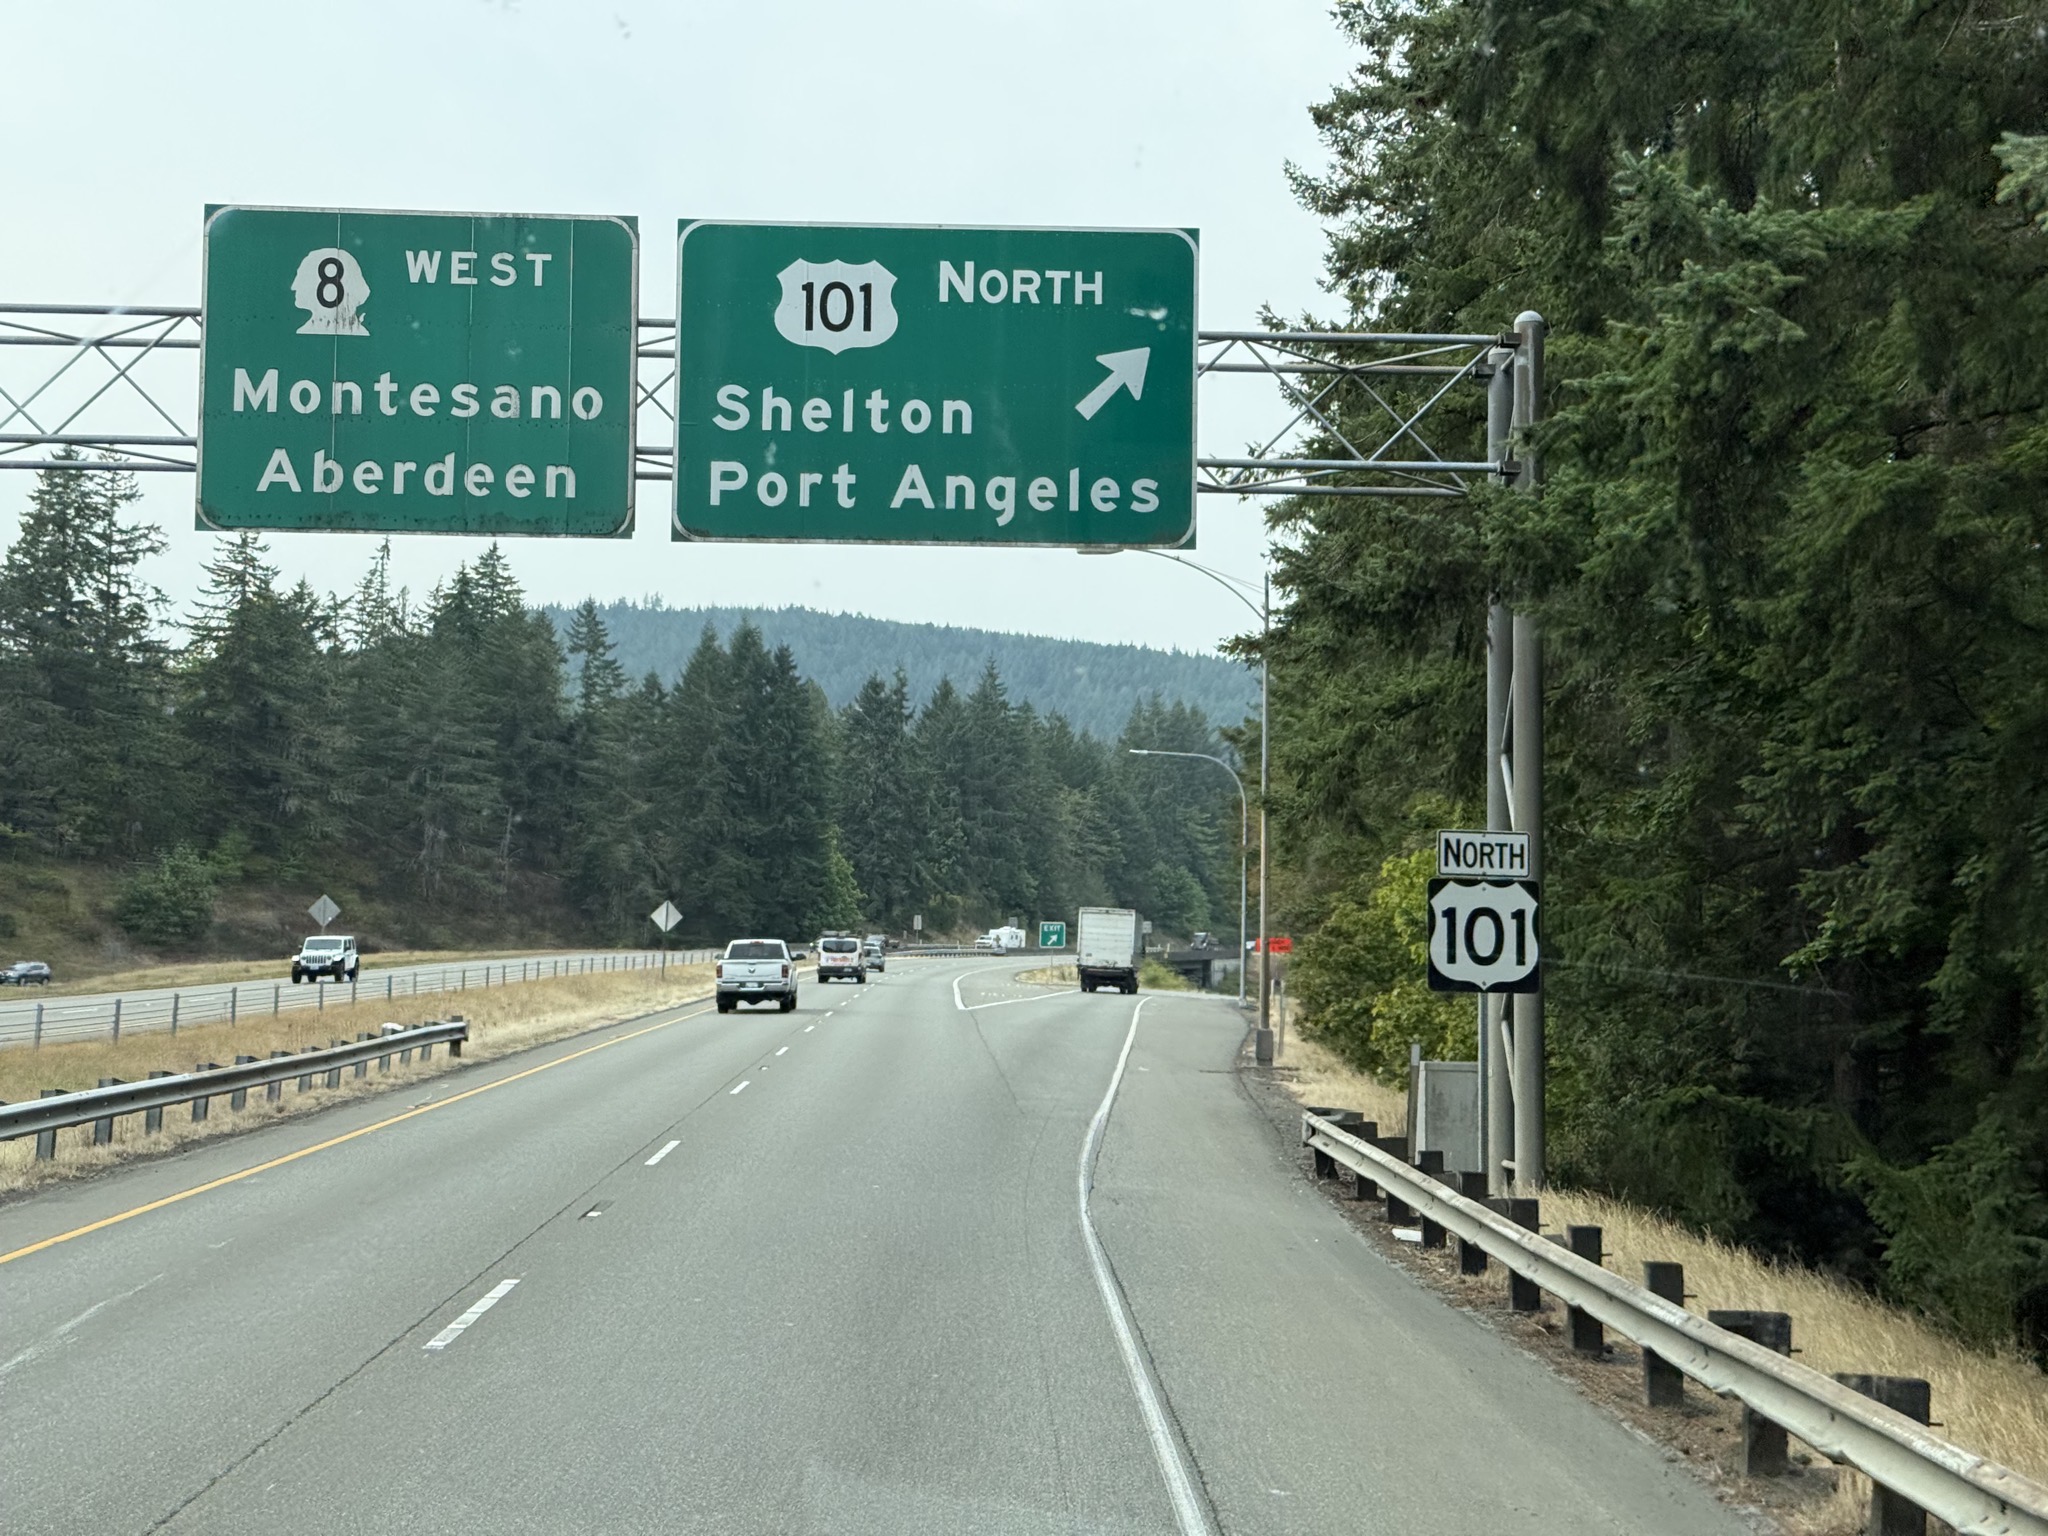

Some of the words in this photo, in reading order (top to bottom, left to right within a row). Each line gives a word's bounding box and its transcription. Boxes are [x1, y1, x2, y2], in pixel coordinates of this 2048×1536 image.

[316, 257, 345, 308] 8
[405, 250, 553, 287] WEST
[938, 260, 1104, 305] NORTH
[801, 281, 873, 332] 101
[233, 368, 604, 420] Montesano
[712, 384, 974, 434] Shelton
[256, 448, 577, 498] Aberdeen
[709, 461, 857, 508] Port
[890, 464, 1160, 527] Angeles
[1443, 838, 1525, 869] NORTH
[1441, 906, 1526, 966] 101
